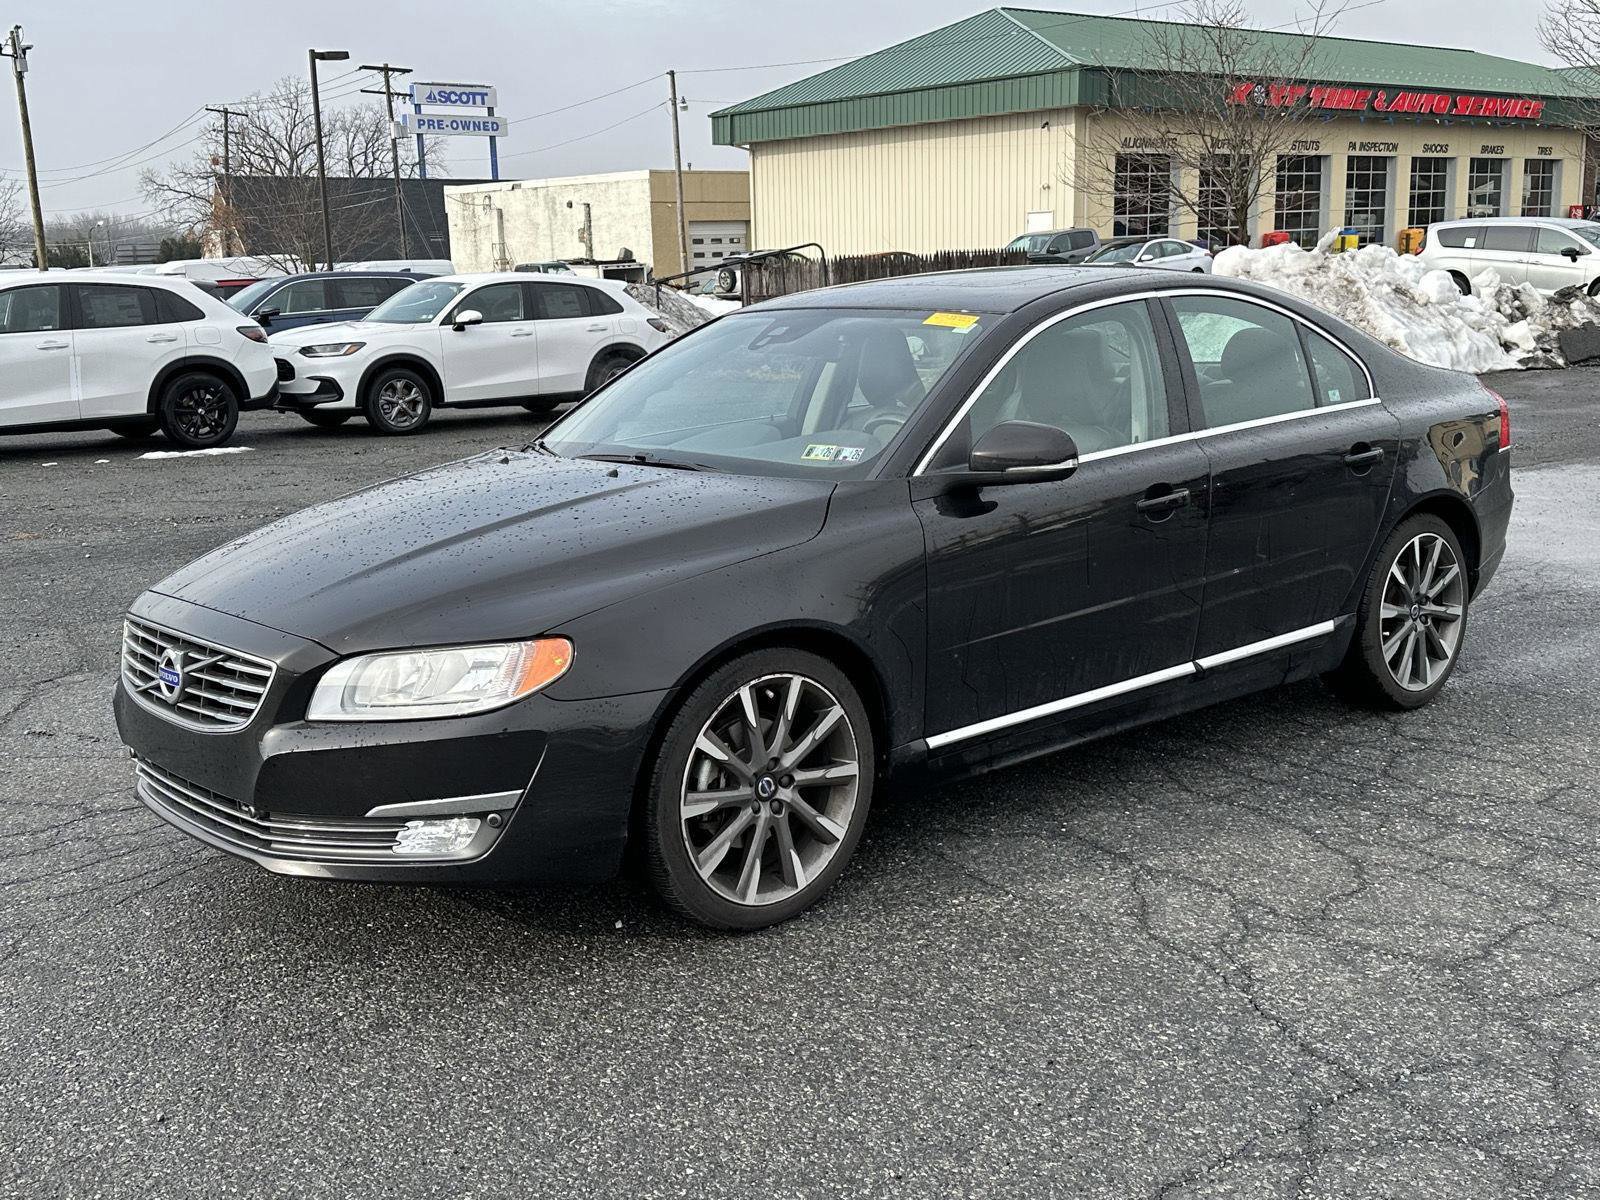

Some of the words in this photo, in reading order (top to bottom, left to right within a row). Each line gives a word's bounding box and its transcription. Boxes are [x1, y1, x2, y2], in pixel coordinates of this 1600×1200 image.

[437, 90, 488, 105] SCOTT
[1309, 87, 1372, 110] TIRE
[1388, 92, 1450, 114] AUTO
[1452, 96, 1545, 118] SERVICE
[417, 119, 499, 132] PRE-OWNED
[1291, 140, 1320, 151] STRUTS
[1348, 141, 1357, 151] PA
[1359, 142, 1399, 152] INSPECTION
[1422, 144, 1449, 154] SHOCKS
[1480, 145, 1504, 155] BRAKES
[1537, 146, 1553, 156] TIRES
[160, 668, 178, 683] VOLVO
